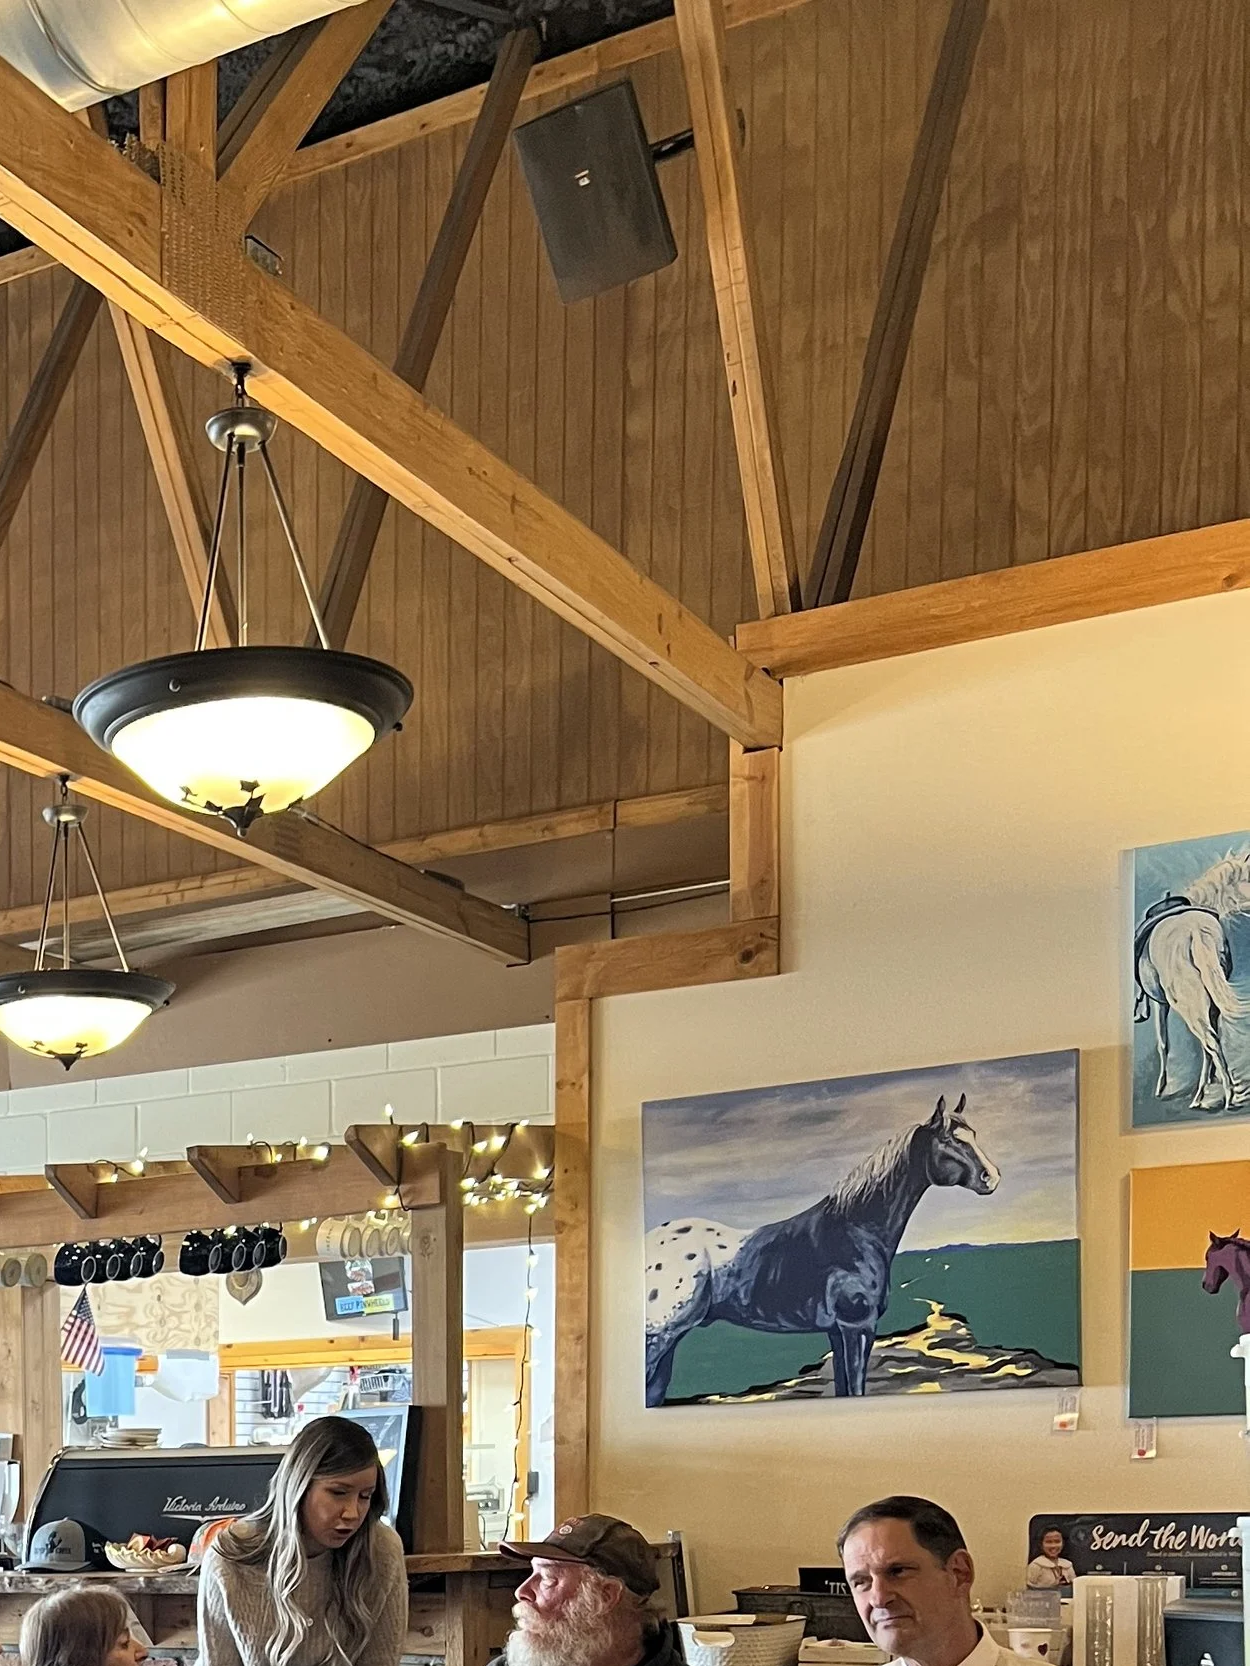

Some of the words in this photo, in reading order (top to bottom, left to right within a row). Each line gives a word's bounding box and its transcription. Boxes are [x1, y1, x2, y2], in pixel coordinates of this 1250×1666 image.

[162, 1495, 202, 1512] Victoria
[204, 1496, 247, 1512] Arduino
[1090, 1518, 1150, 1551] Send
[1150, 1521, 1188, 1550] the
